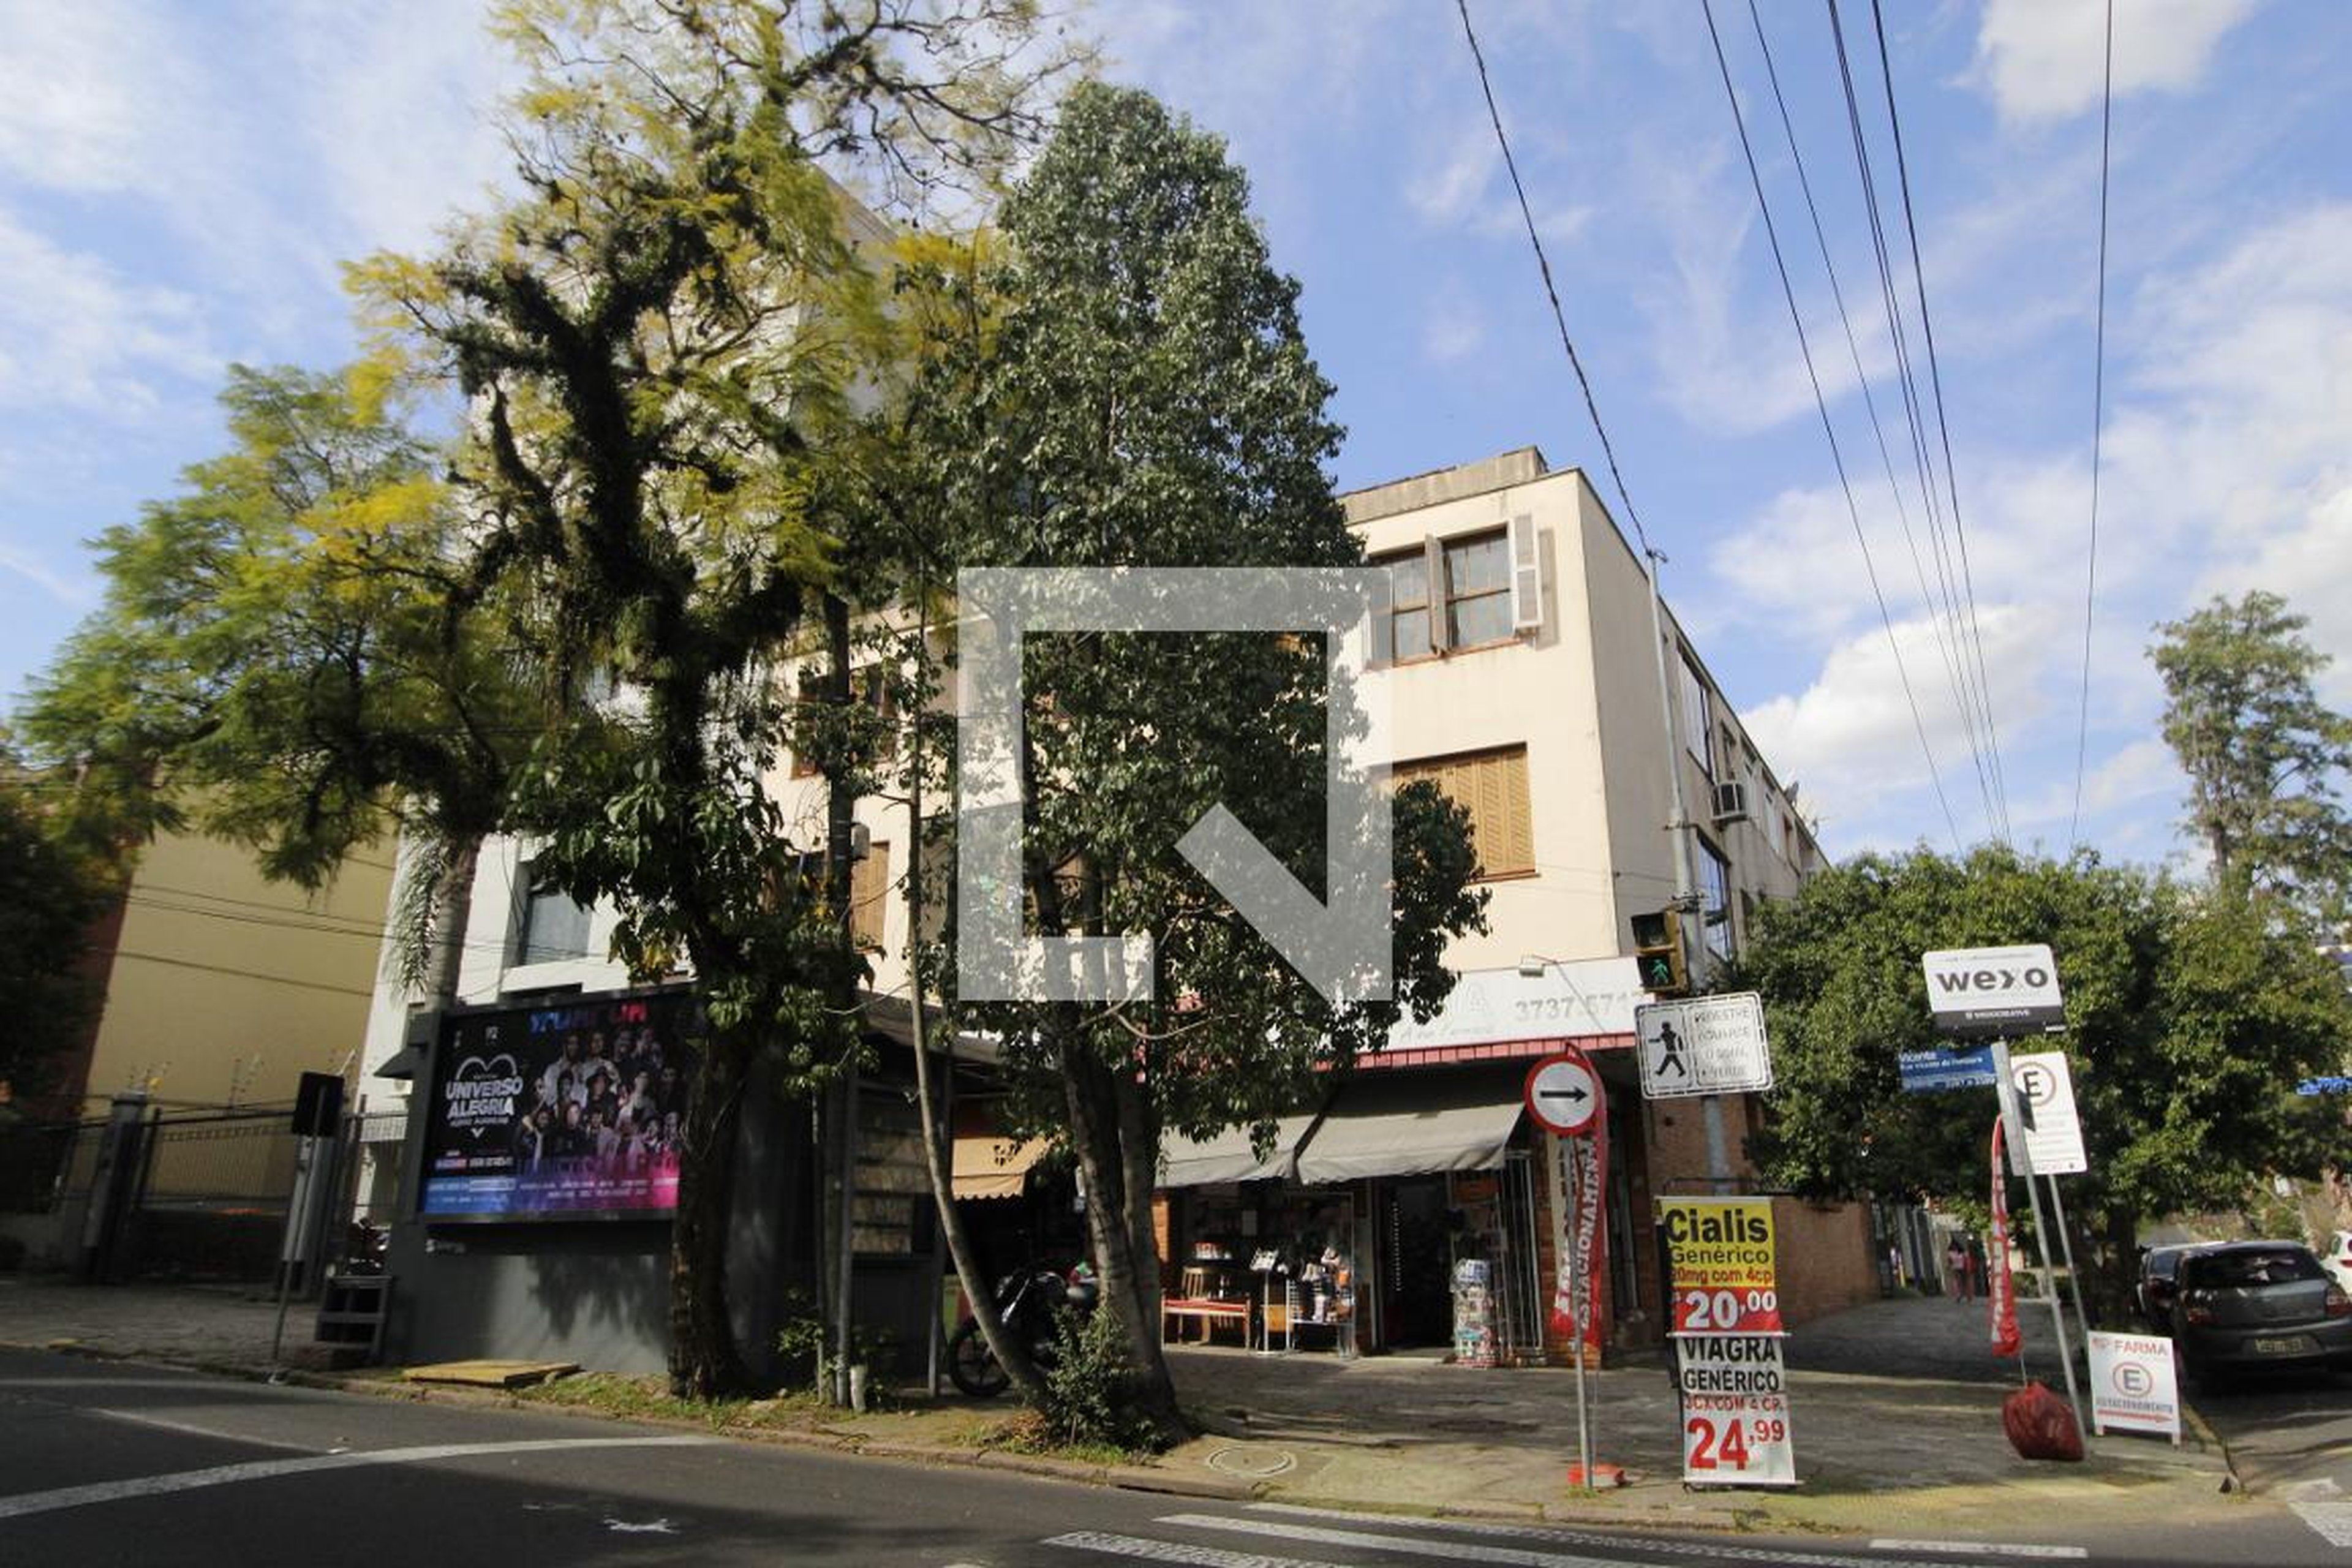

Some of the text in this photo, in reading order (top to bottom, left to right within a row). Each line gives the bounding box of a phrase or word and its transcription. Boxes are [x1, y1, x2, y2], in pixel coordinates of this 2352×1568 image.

[446, 1076, 523, 1100] UNIVERSO
[2023, 1071, 2043, 1096] E
[447, 1096, 514, 1120] ALEGRIA
[1665, 1208, 1769, 1244] Cialis
[1671, 1244, 1770, 1264] Genérico
[1712, 1269, 1742, 1281] com
[1685, 1289, 1776, 1329] 20,00
[1684, 1336, 1776, 1362] VIAGRA
[2114, 1339, 2168, 1356] FARMA
[1684, 1363, 1780, 1392] GENÉRICO
[2122, 1368, 2143, 1391] E
[1687, 1416, 1785, 1471] 24,99
